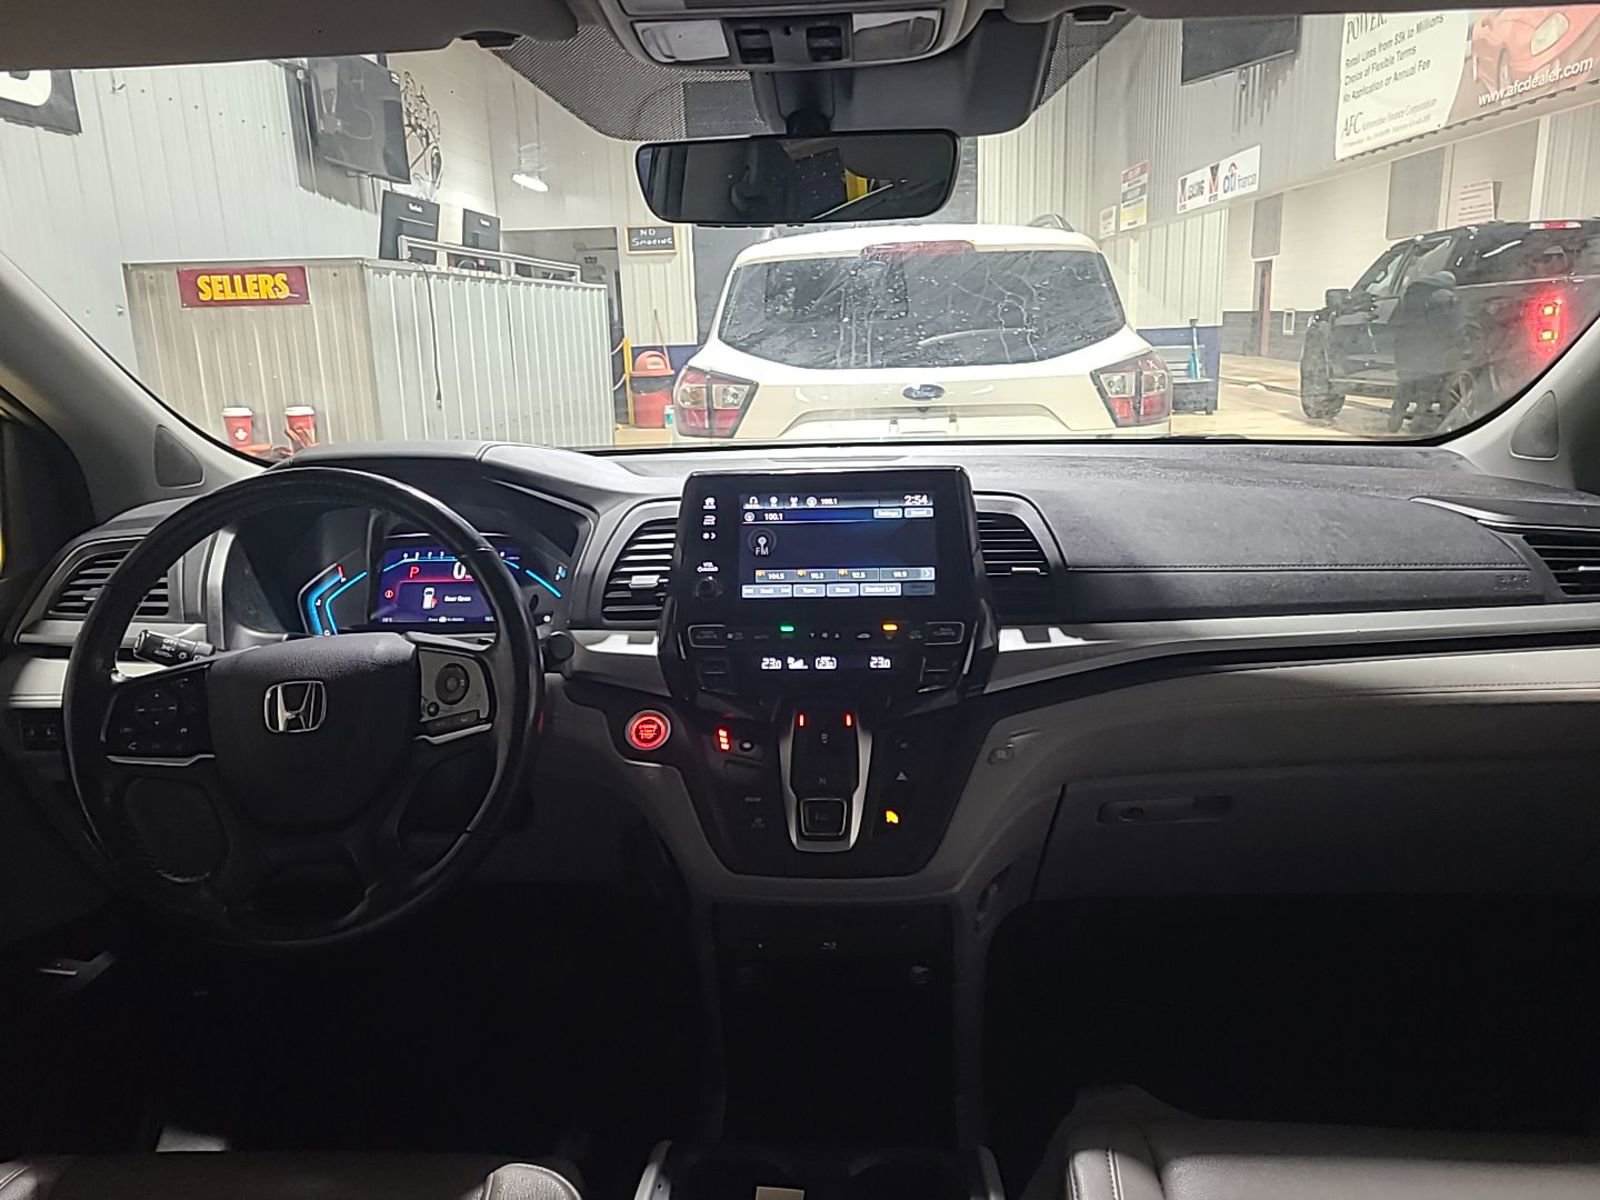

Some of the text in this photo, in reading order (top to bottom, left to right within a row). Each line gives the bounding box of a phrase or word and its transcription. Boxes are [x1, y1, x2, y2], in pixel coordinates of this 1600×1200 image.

[1418, 58, 1431, 72] Fee
[1479, 57, 1593, 106] www.afcdealer.com
[1343, 111, 1363, 137] AFC
[196, 272, 290, 301] SELLERS
[903, 494, 929, 506] 2:54
[763, 512, 784, 521] 100.1
[755, 547, 769, 555] FM
[409, 566, 420, 578] P
[453, 561, 467, 580] 0
